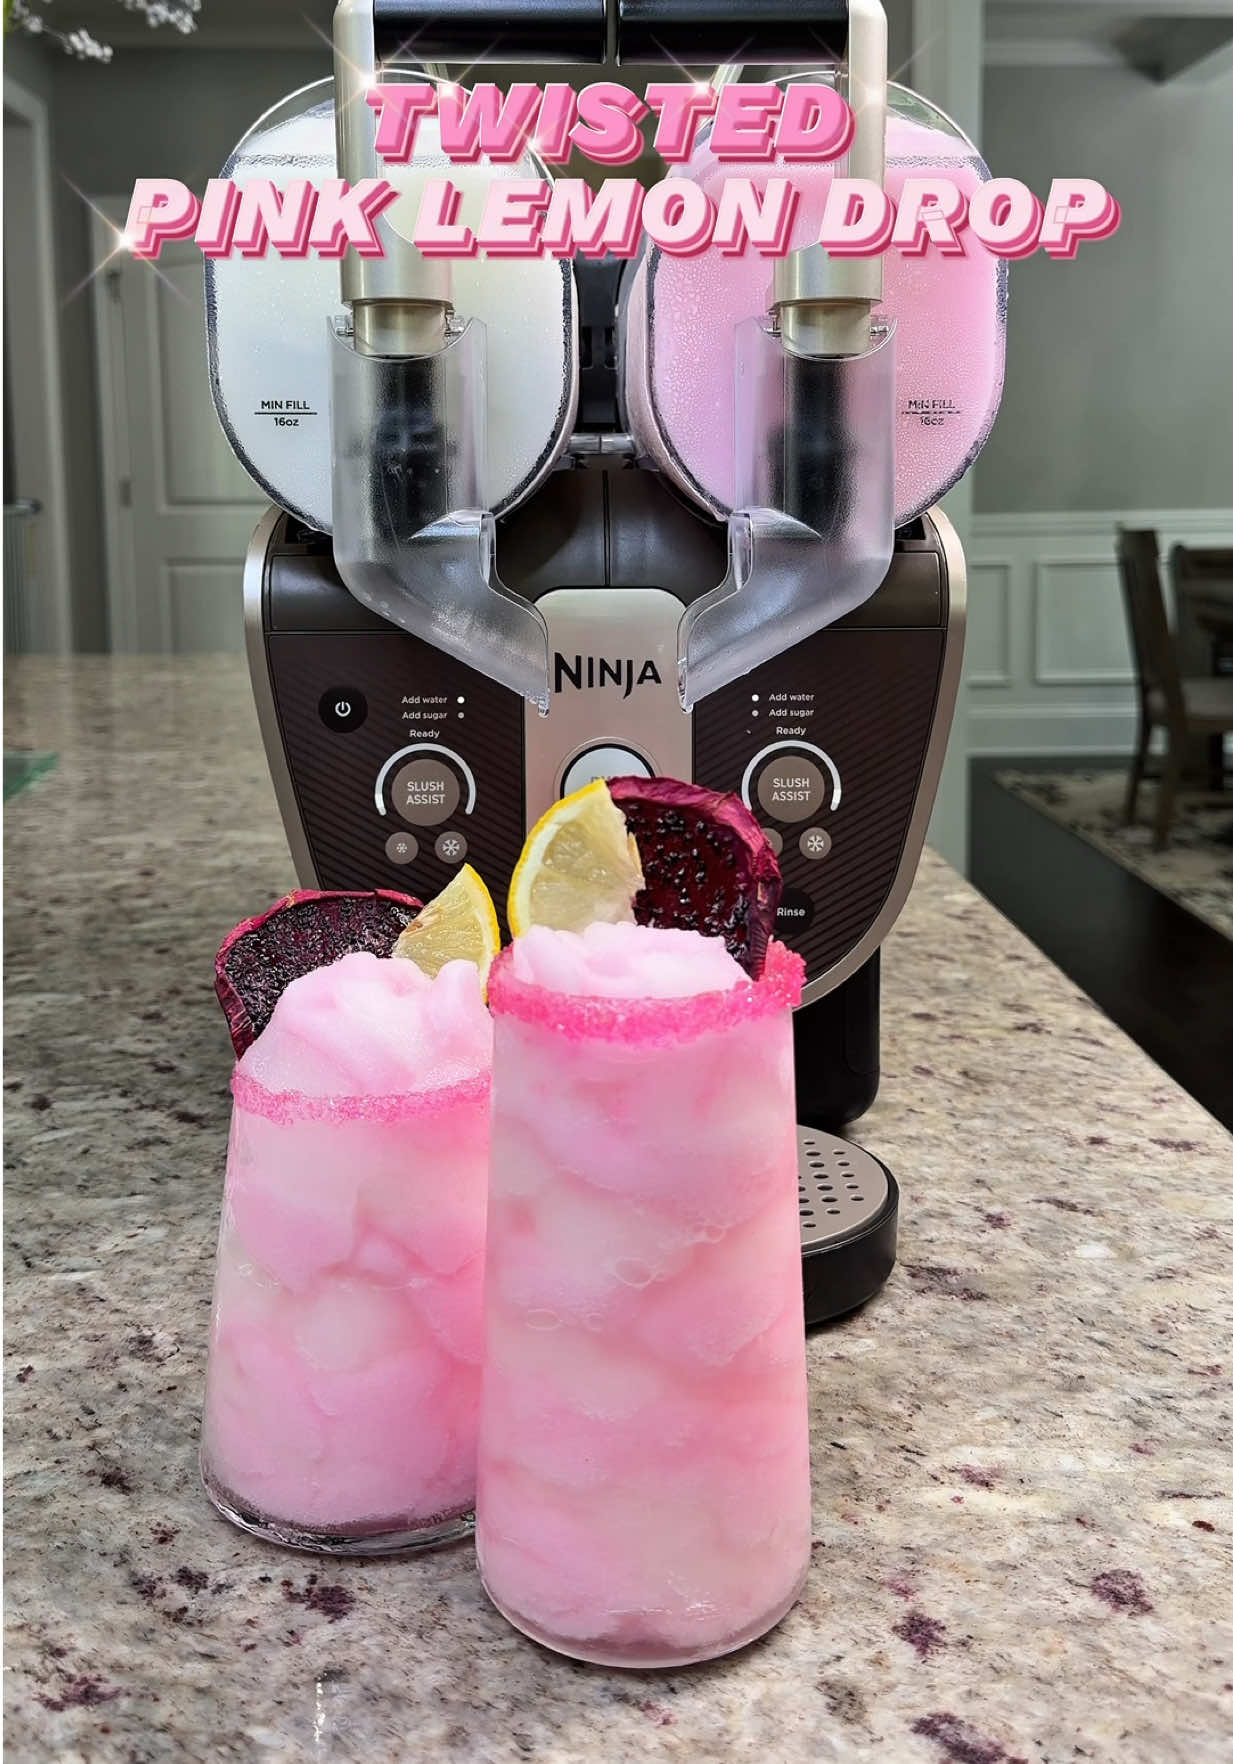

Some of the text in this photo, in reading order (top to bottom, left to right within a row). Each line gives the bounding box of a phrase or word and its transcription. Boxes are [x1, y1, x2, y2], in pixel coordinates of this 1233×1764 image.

[261, 400, 310, 409] MIN FILL
[932, 400, 955, 408] FILL
[274, 417, 299, 426] 16oz
[554, 652, 662, 699] NINJA
[401, 696, 447, 704] Add water
[769, 693, 815, 701] Add water
[401, 711, 447, 722] Add sugar
[769, 708, 814, 718] Add sugar
[409, 729, 440, 739] Ready
[776, 726, 807, 736] Ready
[407, 781, 444, 792] SLUSH
[772, 778, 810, 788] SLUSH
[406, 794, 445, 805] ASSIST
[772, 791, 811, 801] ASSIST
[776, 907, 805, 917] Rinse
